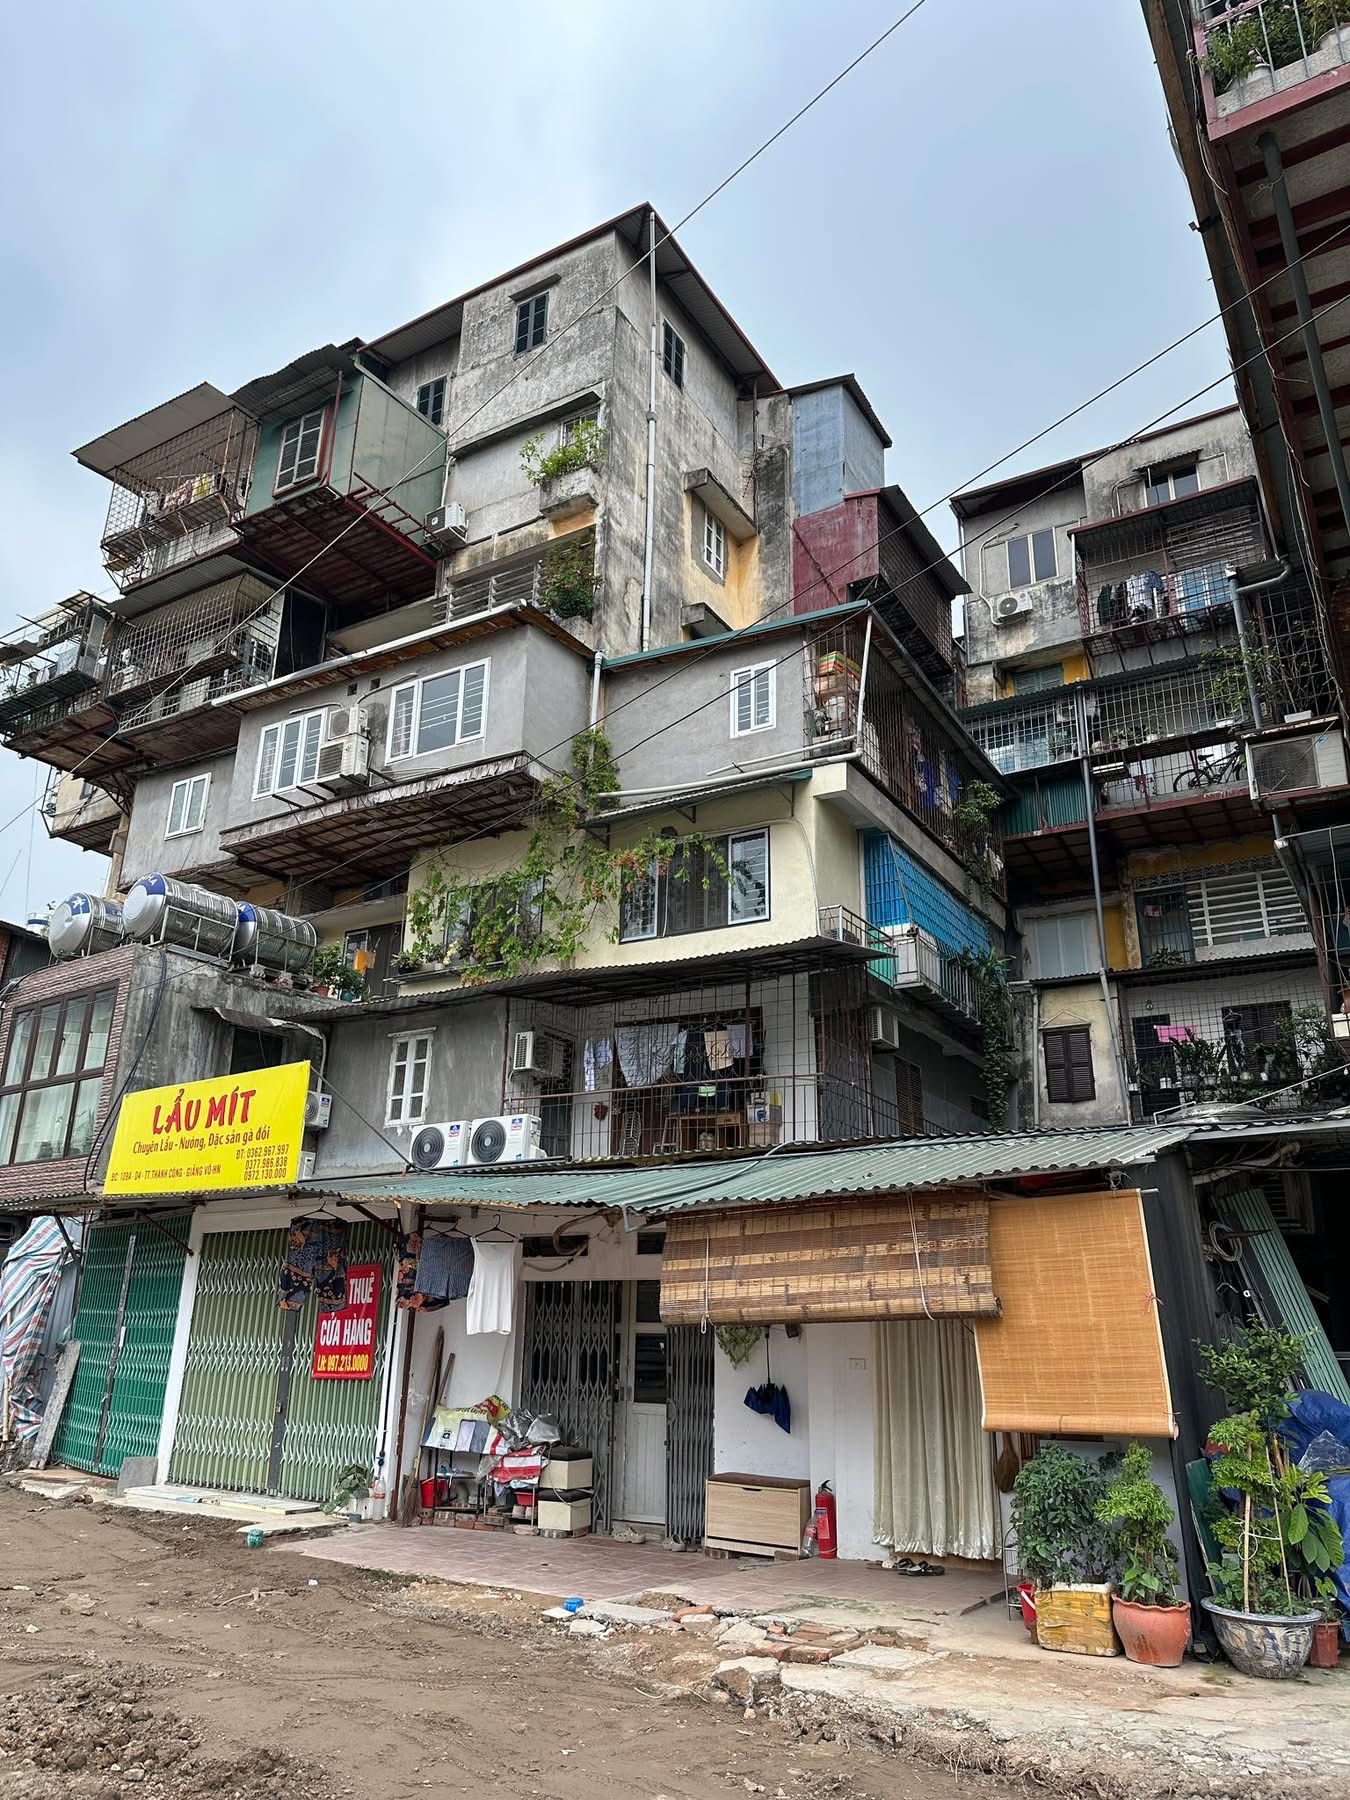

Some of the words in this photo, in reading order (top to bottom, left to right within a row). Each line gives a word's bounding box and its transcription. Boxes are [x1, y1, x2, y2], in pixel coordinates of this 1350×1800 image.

[152, 1088, 201, 1135] LẨU
[205, 1086, 257, 1128] MÍT
[133, 1141, 159, 1156] Chuyên
[160, 1136, 174, 1151] Lẩu
[208, 1132, 224, 1149] Đặc
[225, 1129, 241, 1145] sản
[242, 1128, 254, 1146] gà
[243, 1168, 287, 1181] 0972.130.000
[349, 1271, 375, 1304] THUÊ
[320, 1312, 341, 1346] CỬA
[342, 1313, 373, 1346] HÀNG
